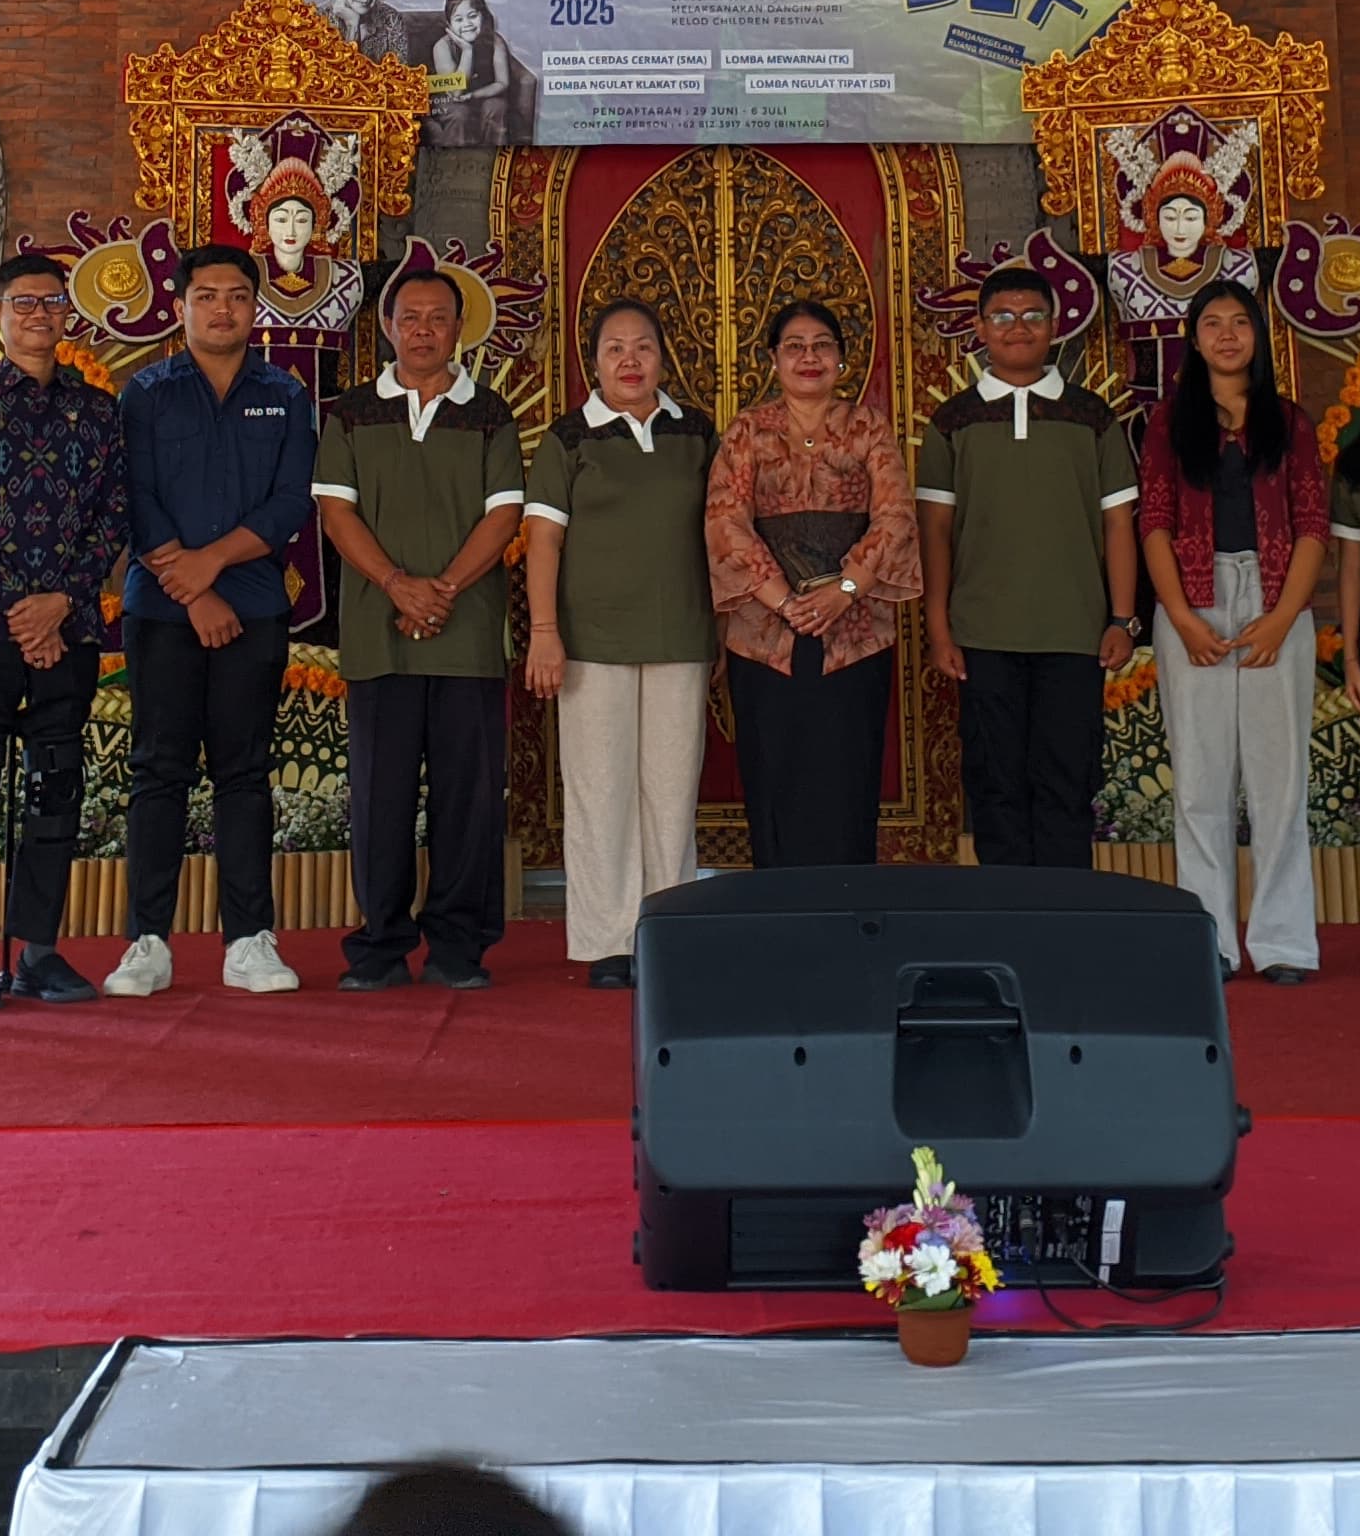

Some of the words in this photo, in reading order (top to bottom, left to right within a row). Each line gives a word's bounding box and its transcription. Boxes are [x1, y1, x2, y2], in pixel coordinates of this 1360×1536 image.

[671, 5, 763, 14] MELAKSANAKAN
[767, 5, 812, 13] DANGIN
[816, 4, 842, 13] PURI
[671, 17, 709, 26] KELOD
[712, 17, 769, 25] CHILDREN
[773, 16, 824, 25] FESTIVAL
[947, 38, 977, 53] RUANG
[547, 56, 586, 66] LOMBA
[588, 55, 629, 65] CERDAS
[631, 55, 674, 65] CERMAT
[676, 55, 707, 66] (SMA)
[725, 55, 764, 64] LOMBA
[766, 55, 826, 64] MEWARNAI
[828, 55, 849, 65] (TK)
[548, 80, 587, 90] LOMBA
[590, 80, 633, 90] NGULAT
[635, 80, 676, 89] KLAKAT
[679, 80, 700, 90] (SD)
[750, 80, 789, 89] LOMBA
[791, 80, 834, 88] NGULAT
[835, 79, 867, 88] TIPAT
[870, 79, 891, 89] (SD)
[693, 106, 707, 115] 29
[711, 106, 738, 115] JUNI
[751, 107, 758, 115] 6
[762, 106, 787, 115] JULI
[573, 121, 622, 129] CONTACT
[625, 120, 668, 129] PERSON
[774, 120, 830, 129] (BINTANG)
